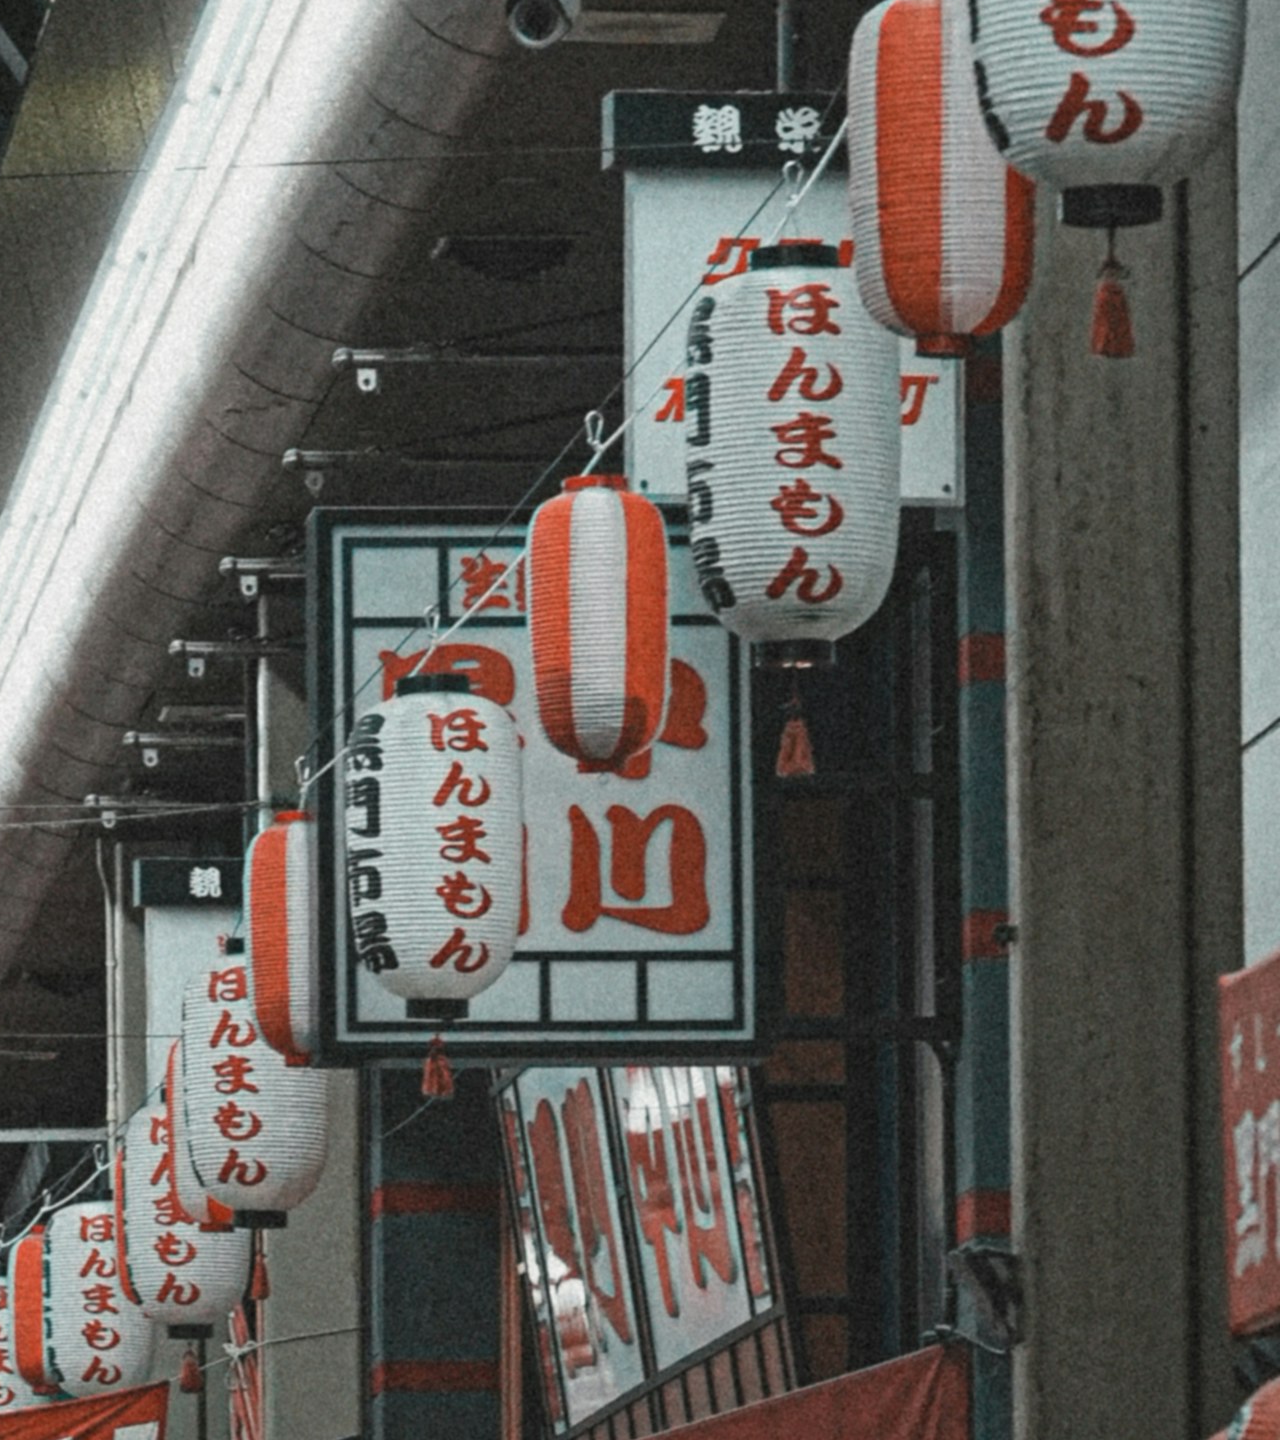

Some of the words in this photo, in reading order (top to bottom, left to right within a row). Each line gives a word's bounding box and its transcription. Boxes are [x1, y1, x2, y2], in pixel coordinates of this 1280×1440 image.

[766, 284, 843, 604] ほんまもん
[429, 708, 491, 974] ほんまもん
[210, 967, 267, 1187] ほんまもん
[79, 1215, 122, 1386] ほんまもん
